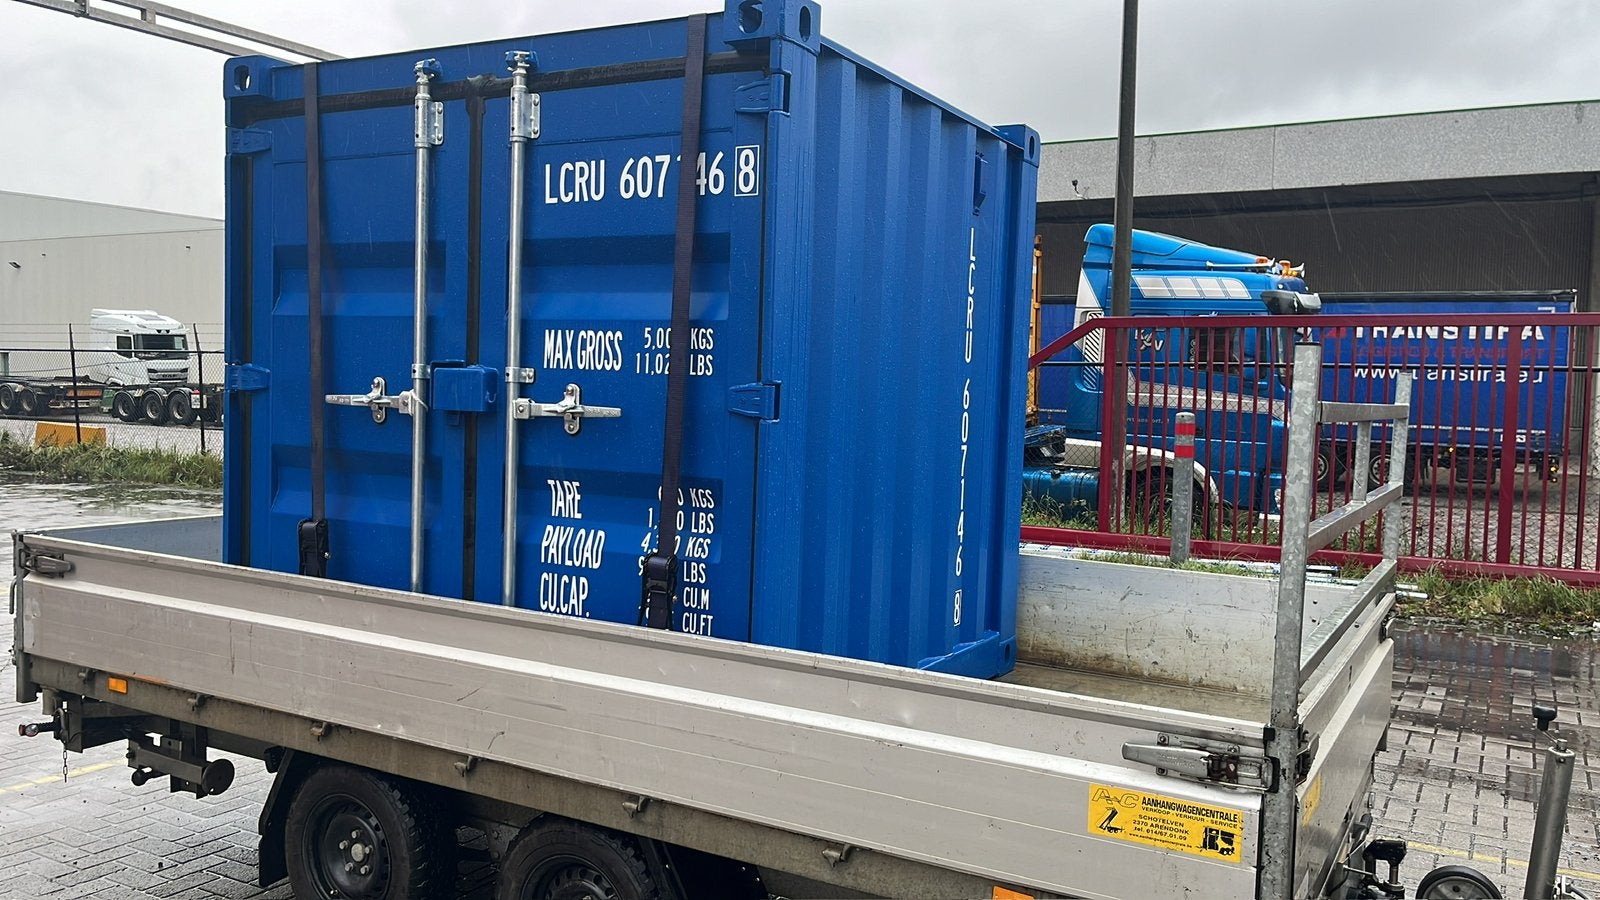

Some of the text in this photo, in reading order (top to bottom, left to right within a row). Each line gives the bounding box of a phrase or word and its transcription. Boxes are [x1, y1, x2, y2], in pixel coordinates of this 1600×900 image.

[545, 148, 756, 204] LCRU 60746 8
[965, 227, 976, 363] LCRU
[543, 329, 623, 371] MAX GROSS
[644, 327, 714, 350] 5,00 KGS
[636, 352, 713, 376] 11,02 LBS
[956, 378, 970, 577] 607146
[547, 479, 582, 519] TARE
[689, 487, 715, 509] KGS
[691, 511, 714, 535] LBS
[541, 525, 606, 569] PAYLOAD
[685, 536, 711, 559] KGS
[683, 561, 706, 584] LBS
[540, 572, 590, 618] CU.CAP.
[683, 587, 710, 610] CU.M
[682, 612, 714, 636] CU.FT
[1138, 814, 1184, 828] SCHOTELVEN
[1141, 796, 1238, 823] AANHANGWAGENCENTRALE
[1142, 806, 1238, 829] VERKOOP VERHUUR SERVICE
[1149, 822, 1189, 836] ARENDONK
